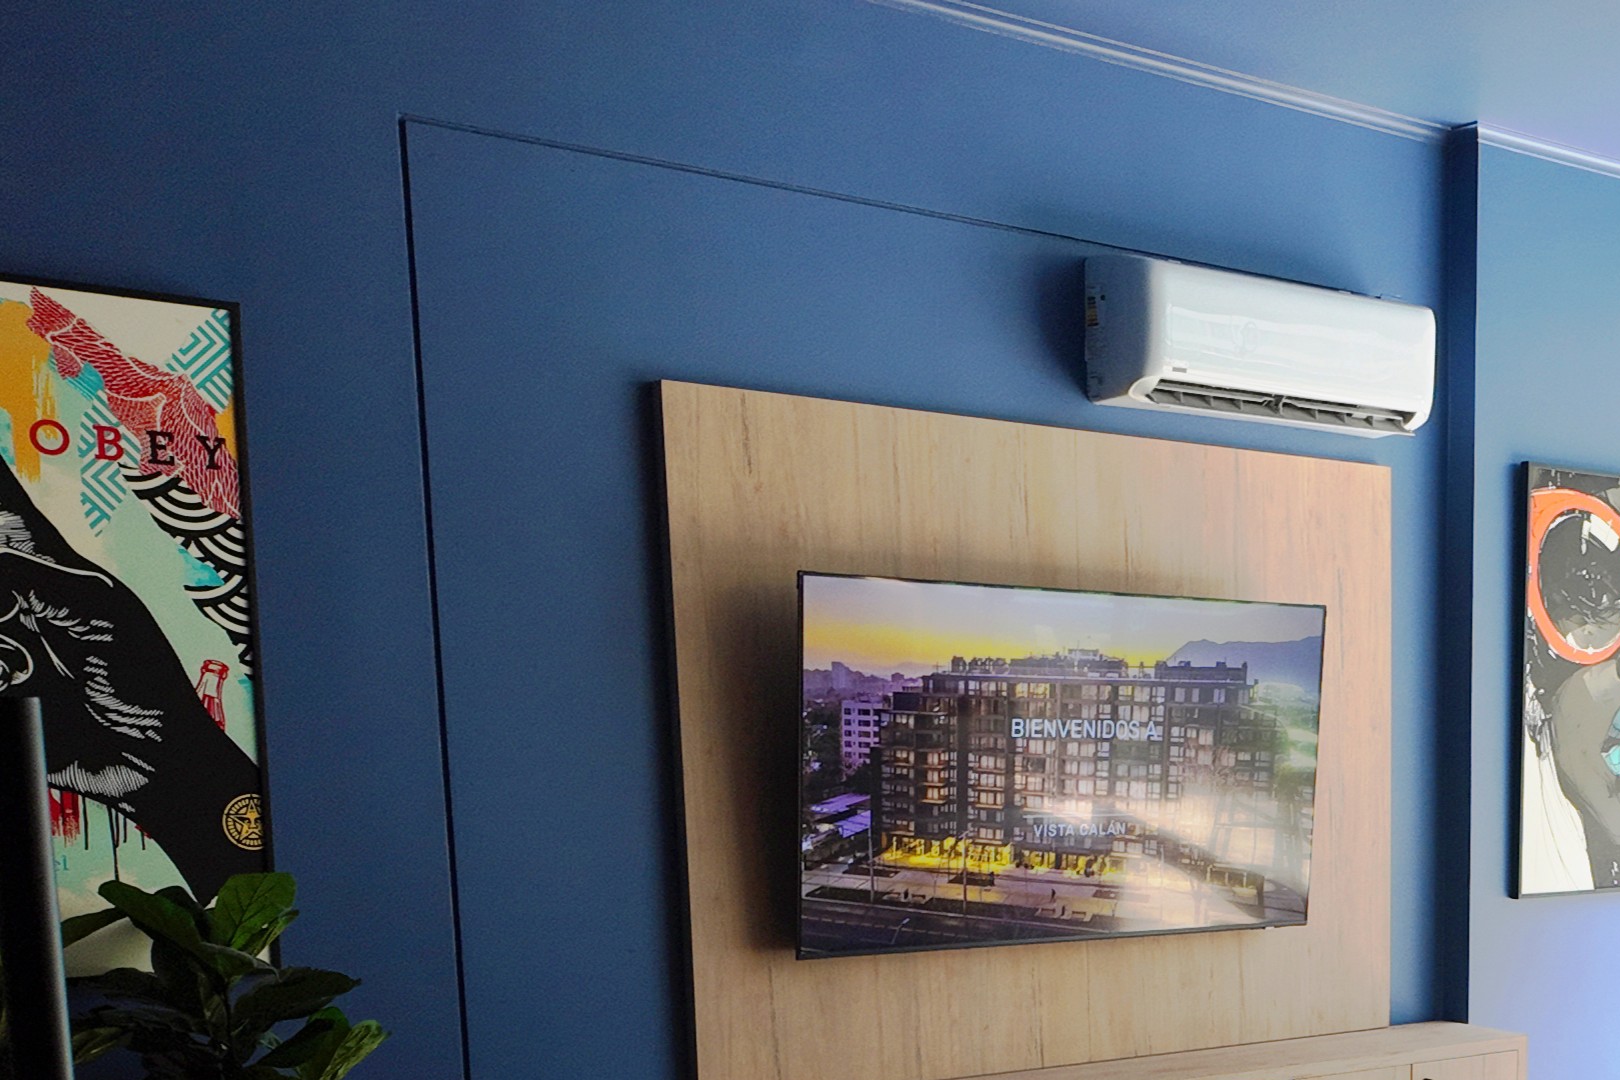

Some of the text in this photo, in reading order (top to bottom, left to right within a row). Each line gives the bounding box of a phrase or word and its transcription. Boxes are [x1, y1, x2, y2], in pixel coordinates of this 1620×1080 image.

[29, 419, 226, 470] OBEY
[1011, 718, 1159, 741] BIENVENIDOS A
[1033, 819, 1126, 838] VISTA CALÁN
